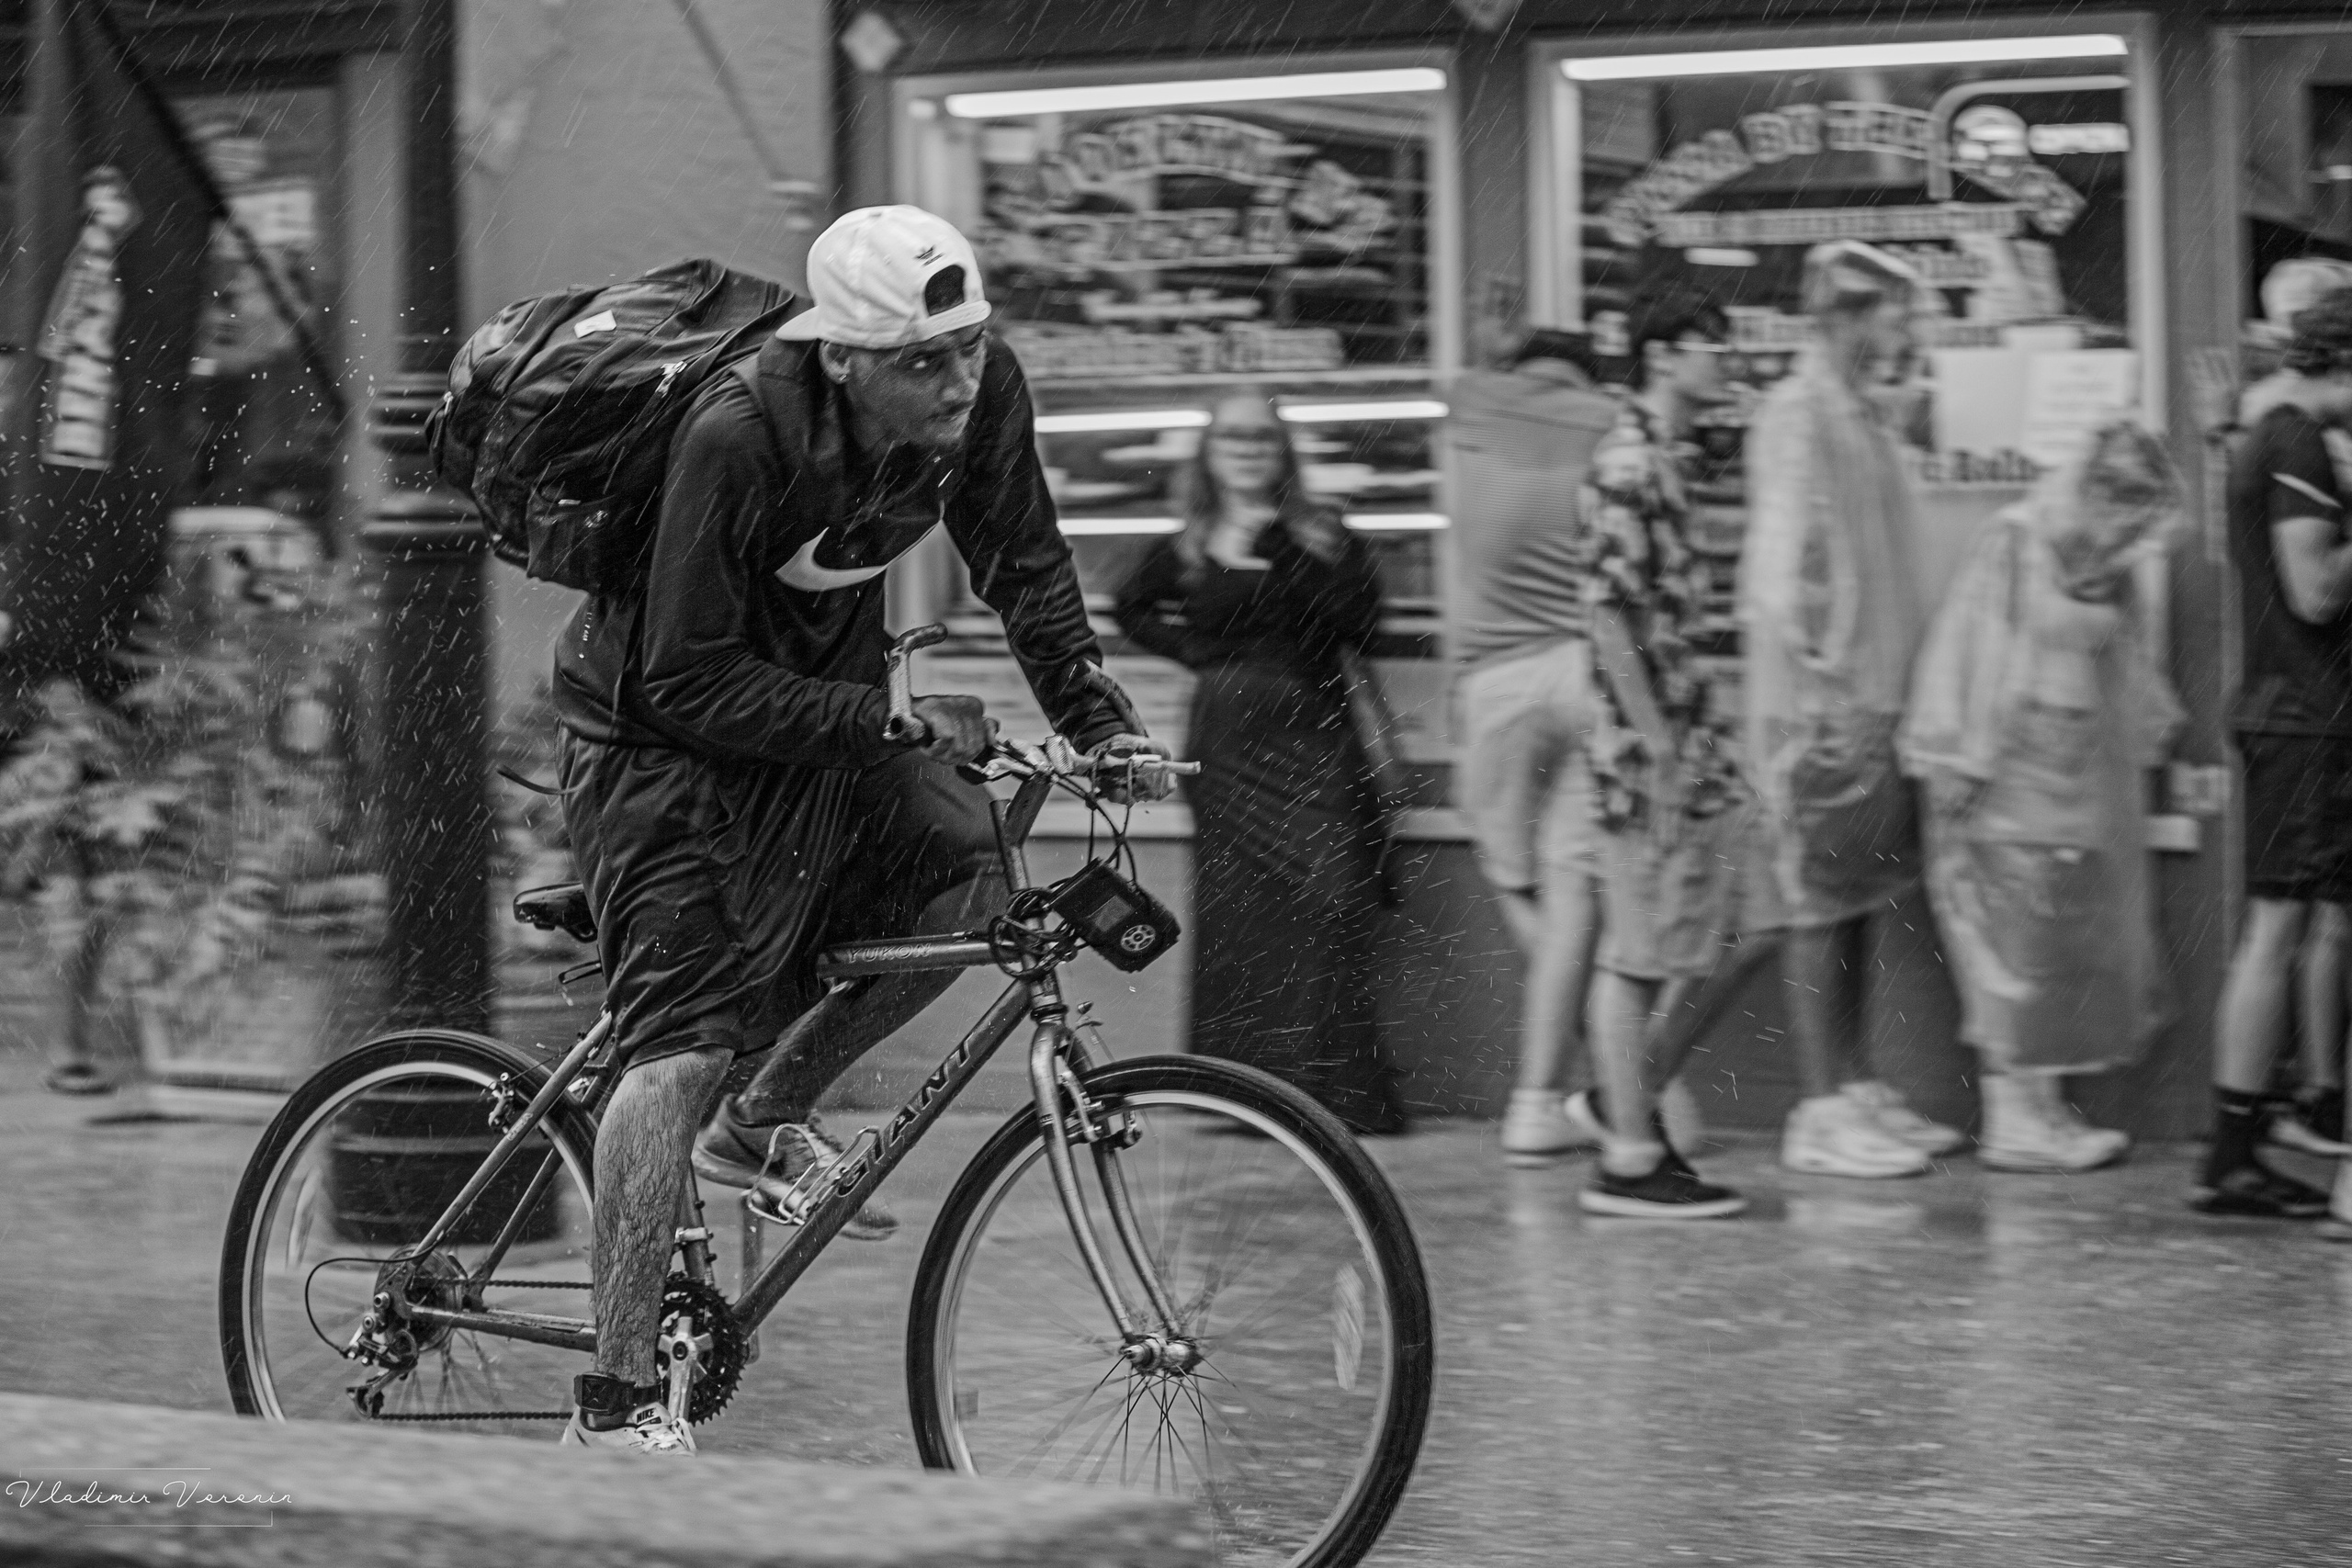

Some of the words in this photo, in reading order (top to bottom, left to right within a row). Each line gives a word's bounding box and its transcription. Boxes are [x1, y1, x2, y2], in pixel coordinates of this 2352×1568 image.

[846, 942, 933, 964] YUKON
[835, 1029, 976, 1198] GIANT
[637, 1407, 657, 1424] NIKE
